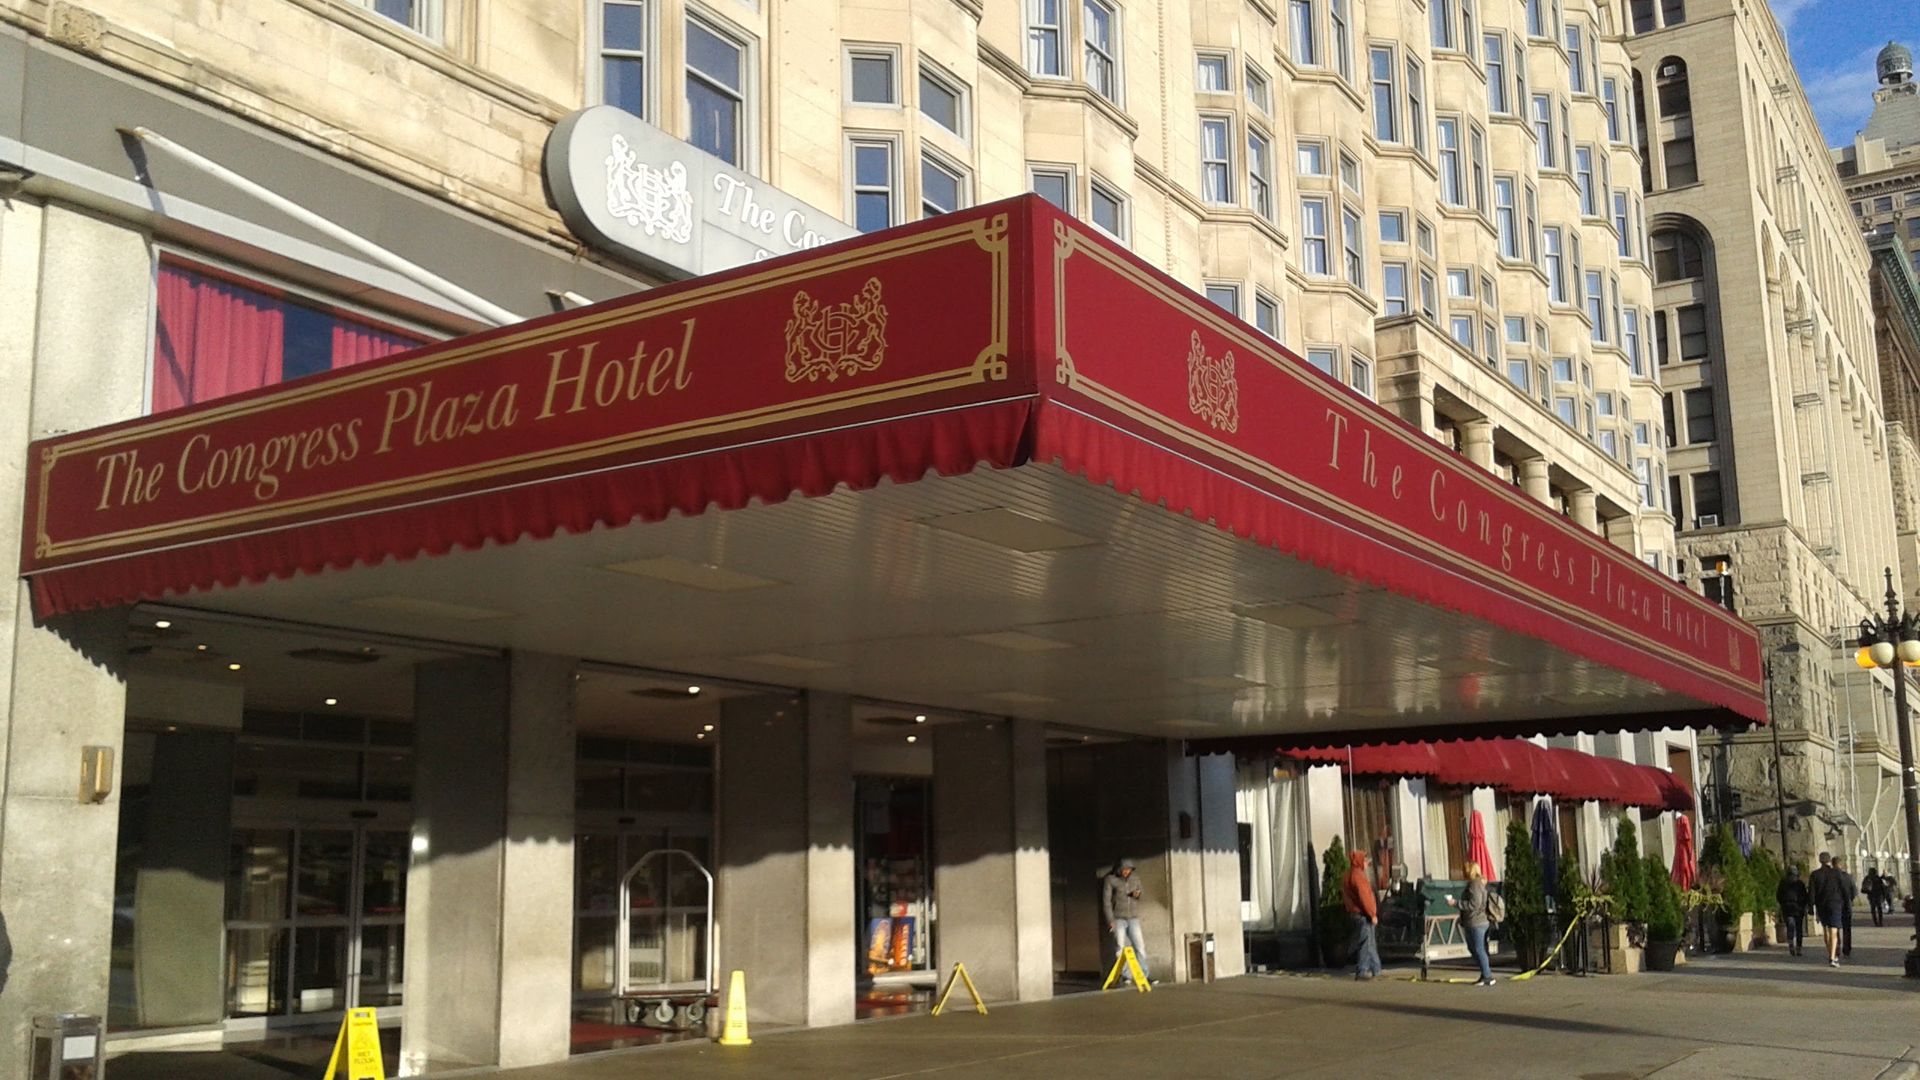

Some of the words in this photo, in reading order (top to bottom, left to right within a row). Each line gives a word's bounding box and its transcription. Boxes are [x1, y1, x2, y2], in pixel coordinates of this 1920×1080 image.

[713, 172, 776, 234] The
[96, 449, 164, 511] The
[177, 417, 363, 500] Congress
[373, 381, 519, 454] Plaza
[534, 318, 697, 421] Hotel
[1325, 407, 1403, 500] The
[1430, 468, 1575, 586] Congress
[1589, 554, 1651, 623] Plaza
[1661, 593, 1708, 649] Hotel
